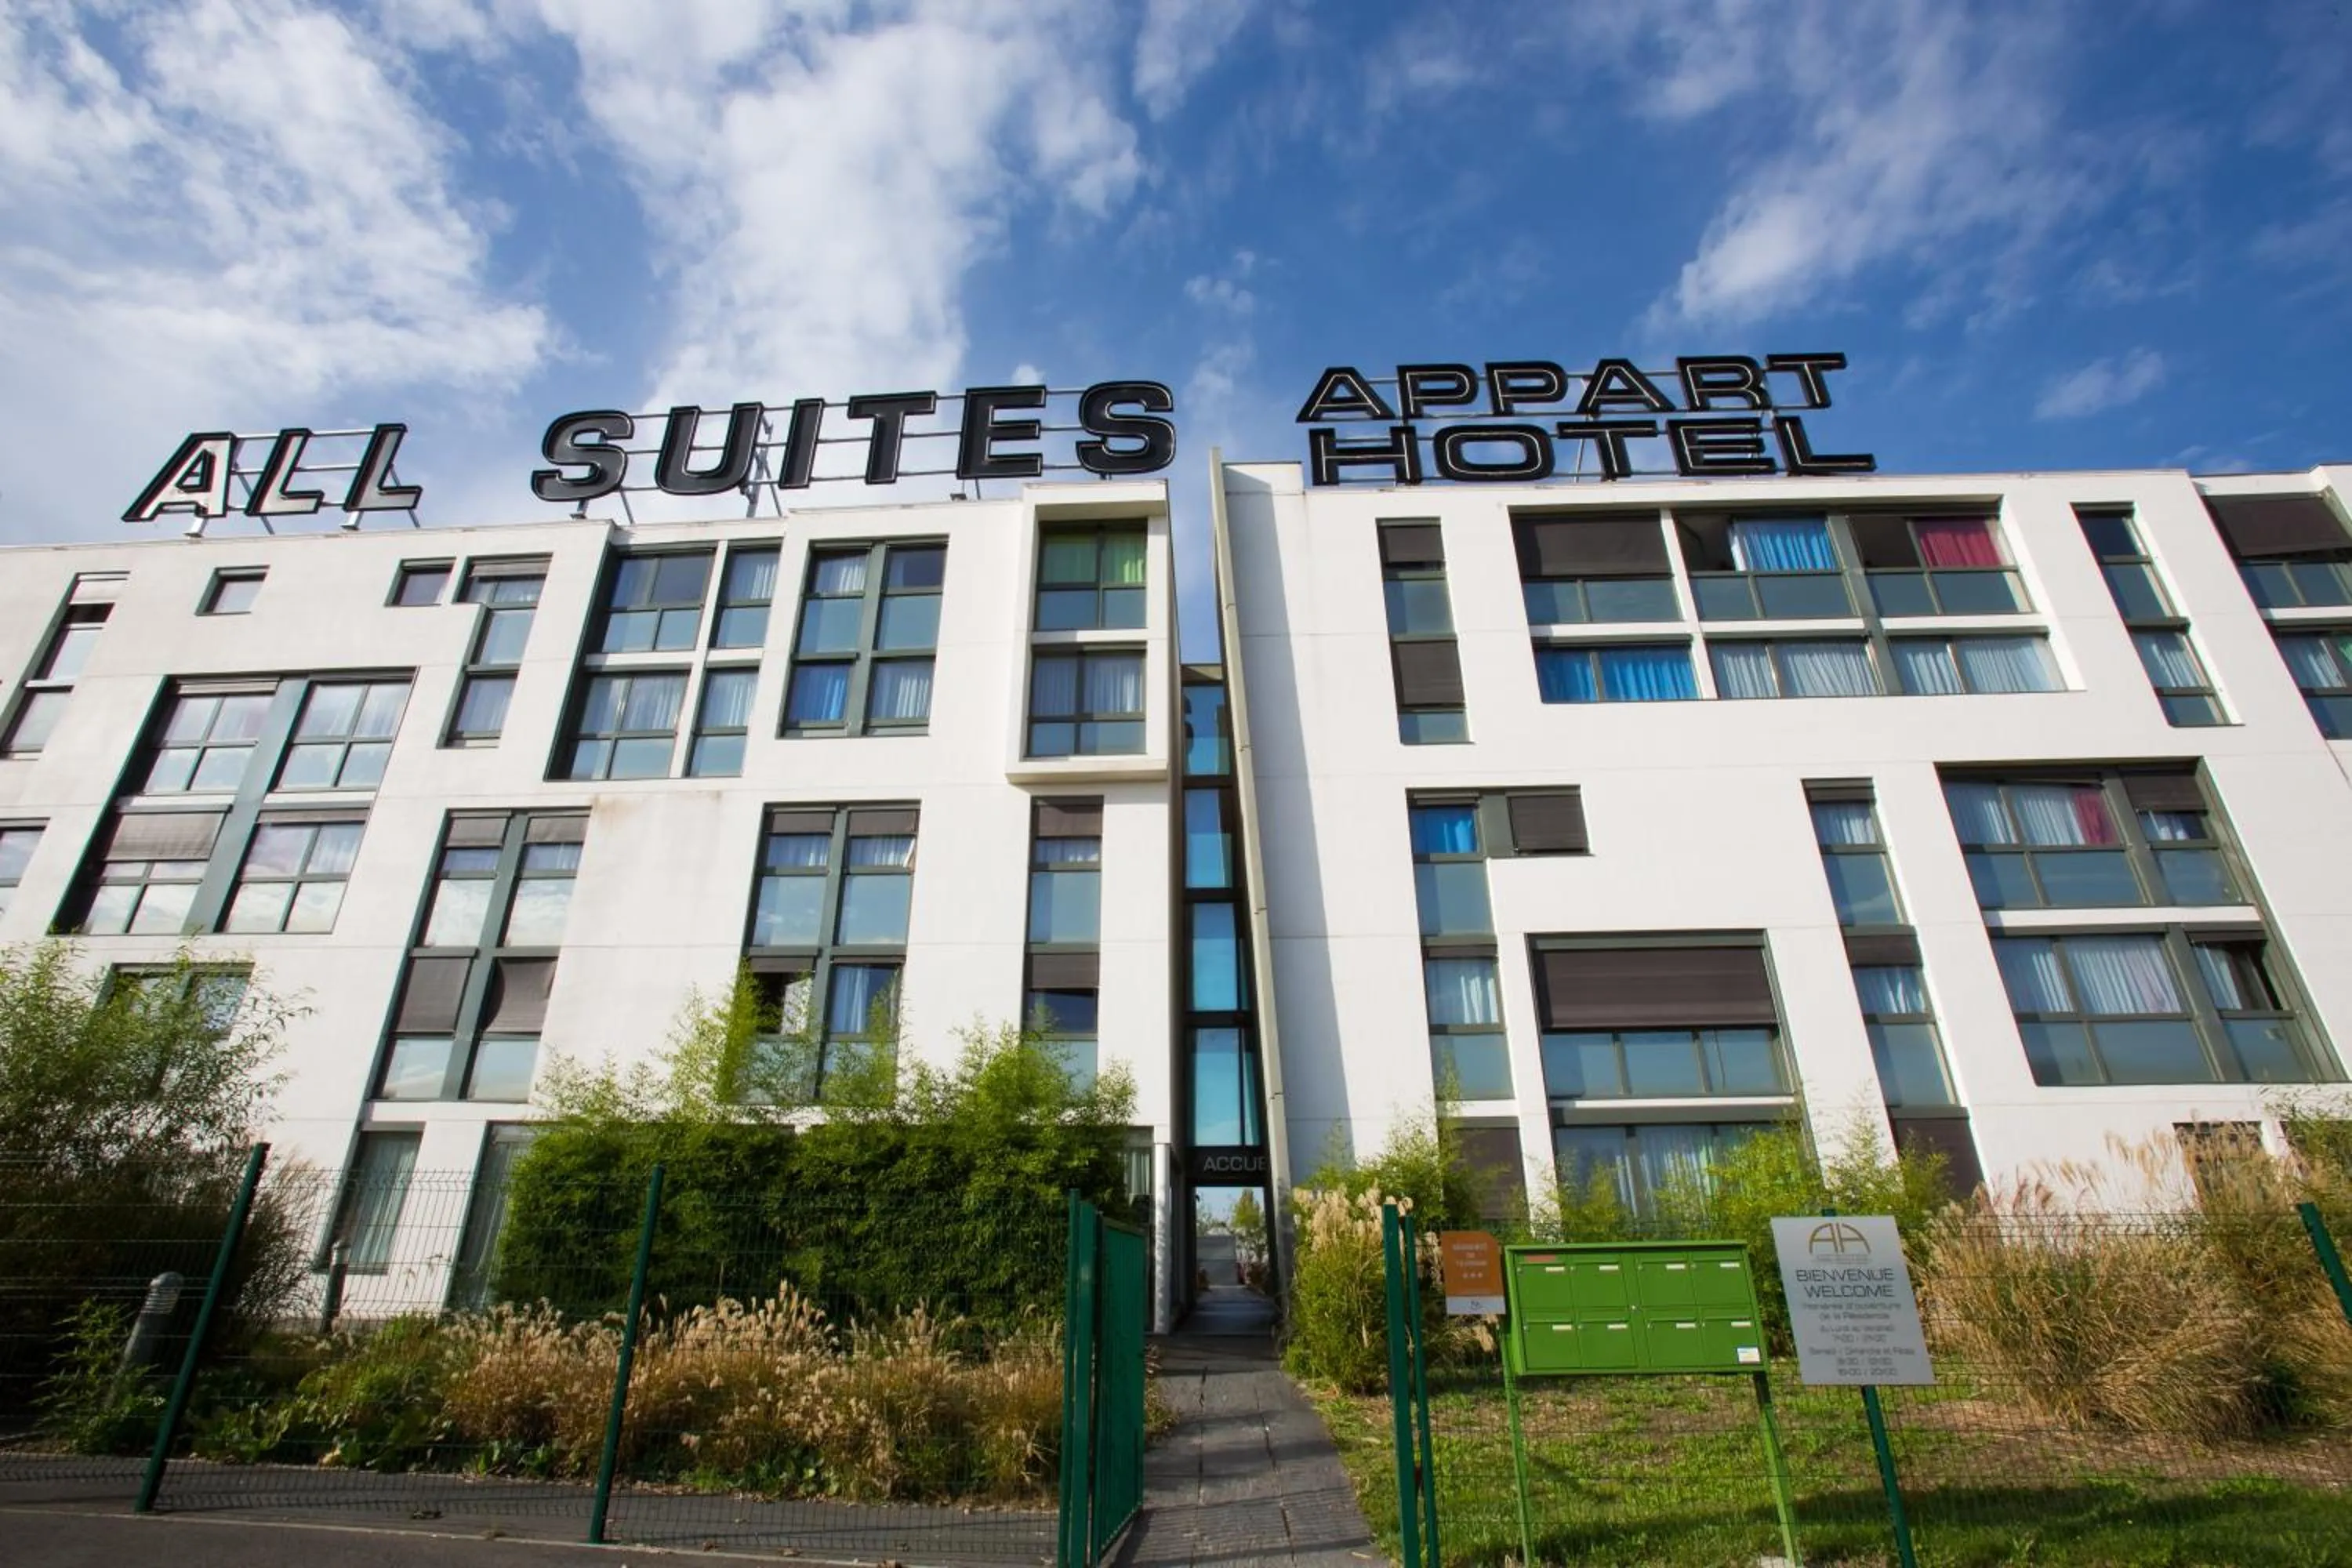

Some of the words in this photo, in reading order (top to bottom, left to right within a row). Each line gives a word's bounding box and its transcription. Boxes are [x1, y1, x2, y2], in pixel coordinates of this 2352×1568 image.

[1295, 351, 1848, 423] APPART
[122, 423, 423, 521] ALL
[531, 380, 1177, 502] SUITES
[1308, 415, 1877, 486] HOTEL
[1795, 1268, 1895, 1283] BIENVENUE
[1804, 1284, 1894, 1298] WELCOME
